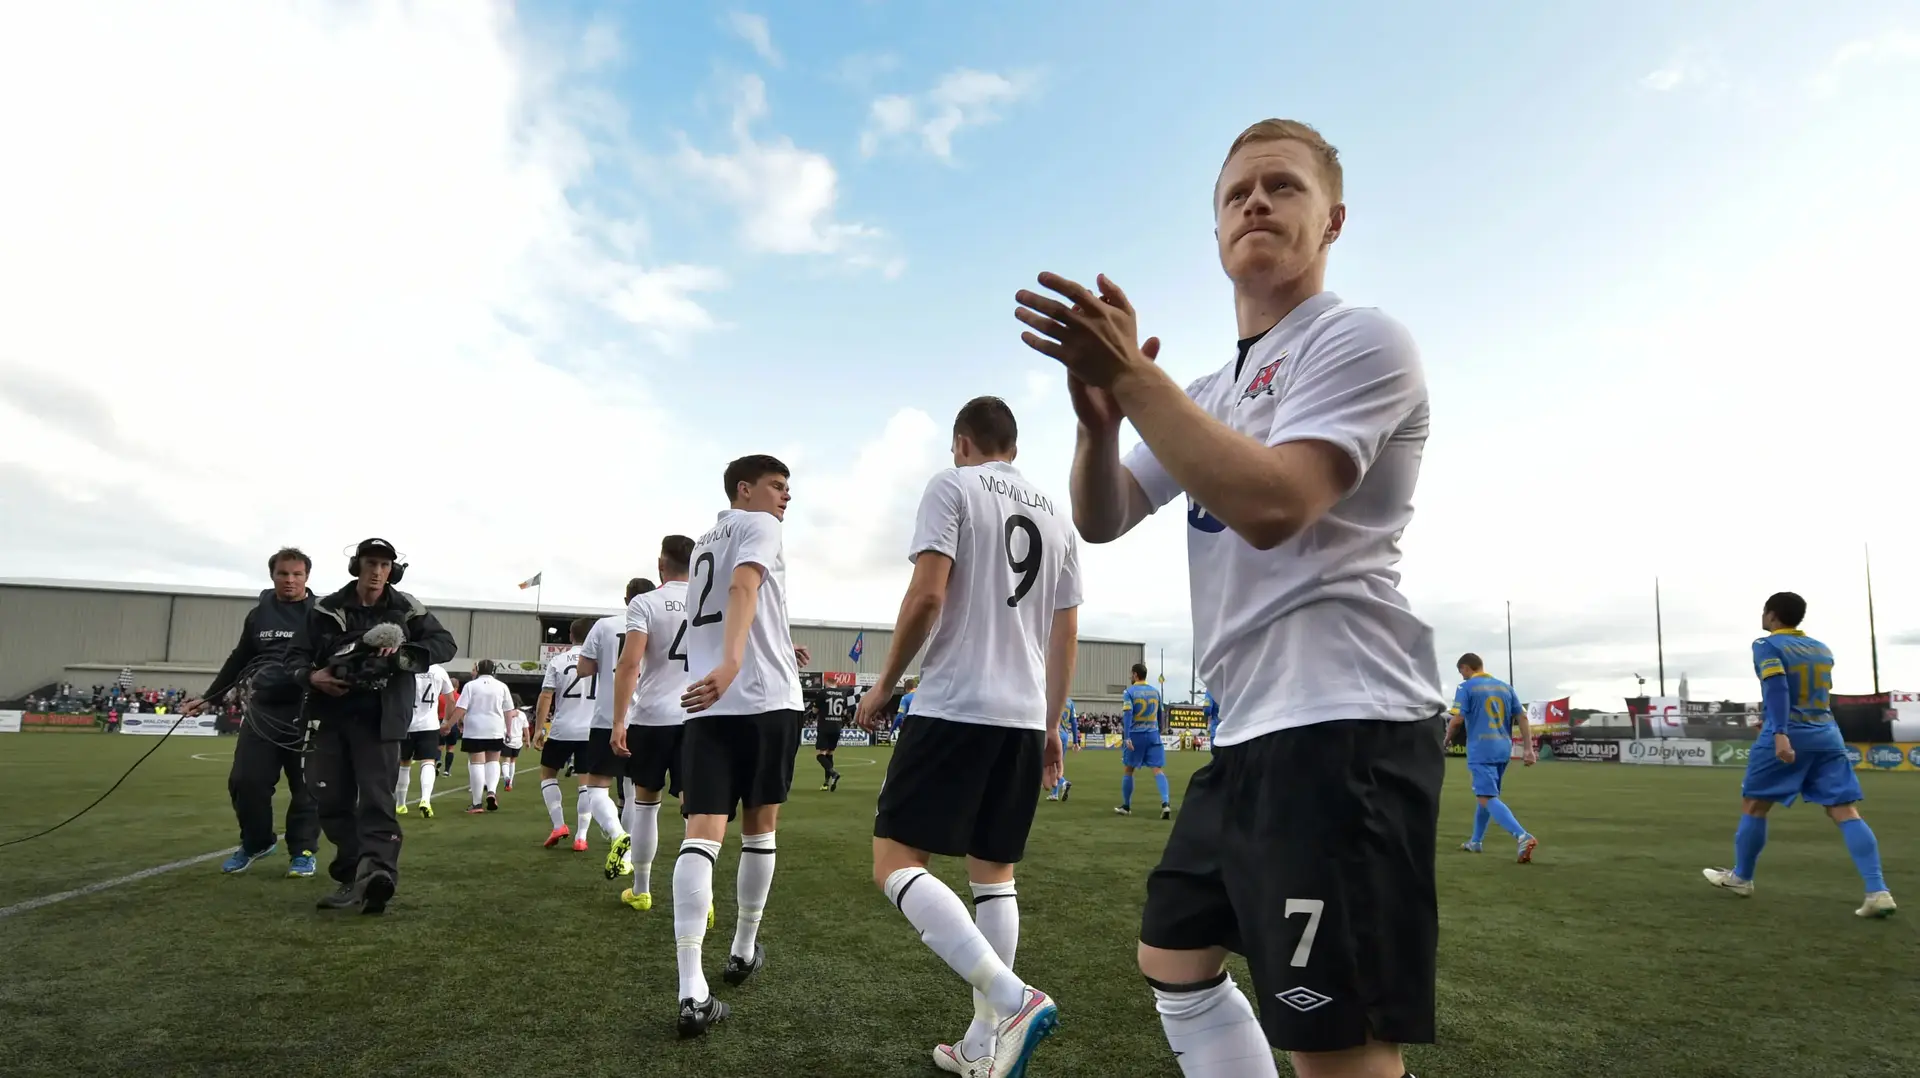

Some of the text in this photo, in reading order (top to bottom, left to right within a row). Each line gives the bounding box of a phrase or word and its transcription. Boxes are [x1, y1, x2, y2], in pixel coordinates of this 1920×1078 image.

[979, 474, 1054, 516] McMILLAN
[1004, 514, 1042, 608] 9
[692, 552, 722, 627] 2
[668, 619, 689, 672] 4
[563, 664, 598, 700] 21
[834, 673, 851, 683] 500
[1789, 663, 1833, 710] 15
[826, 697, 845, 715] 16
[1133, 698, 1159, 721] 22
[1485, 696, 1505, 728] 9
[1647, 746, 1706, 760] Digiweb
[1284, 898, 1325, 968] 7
